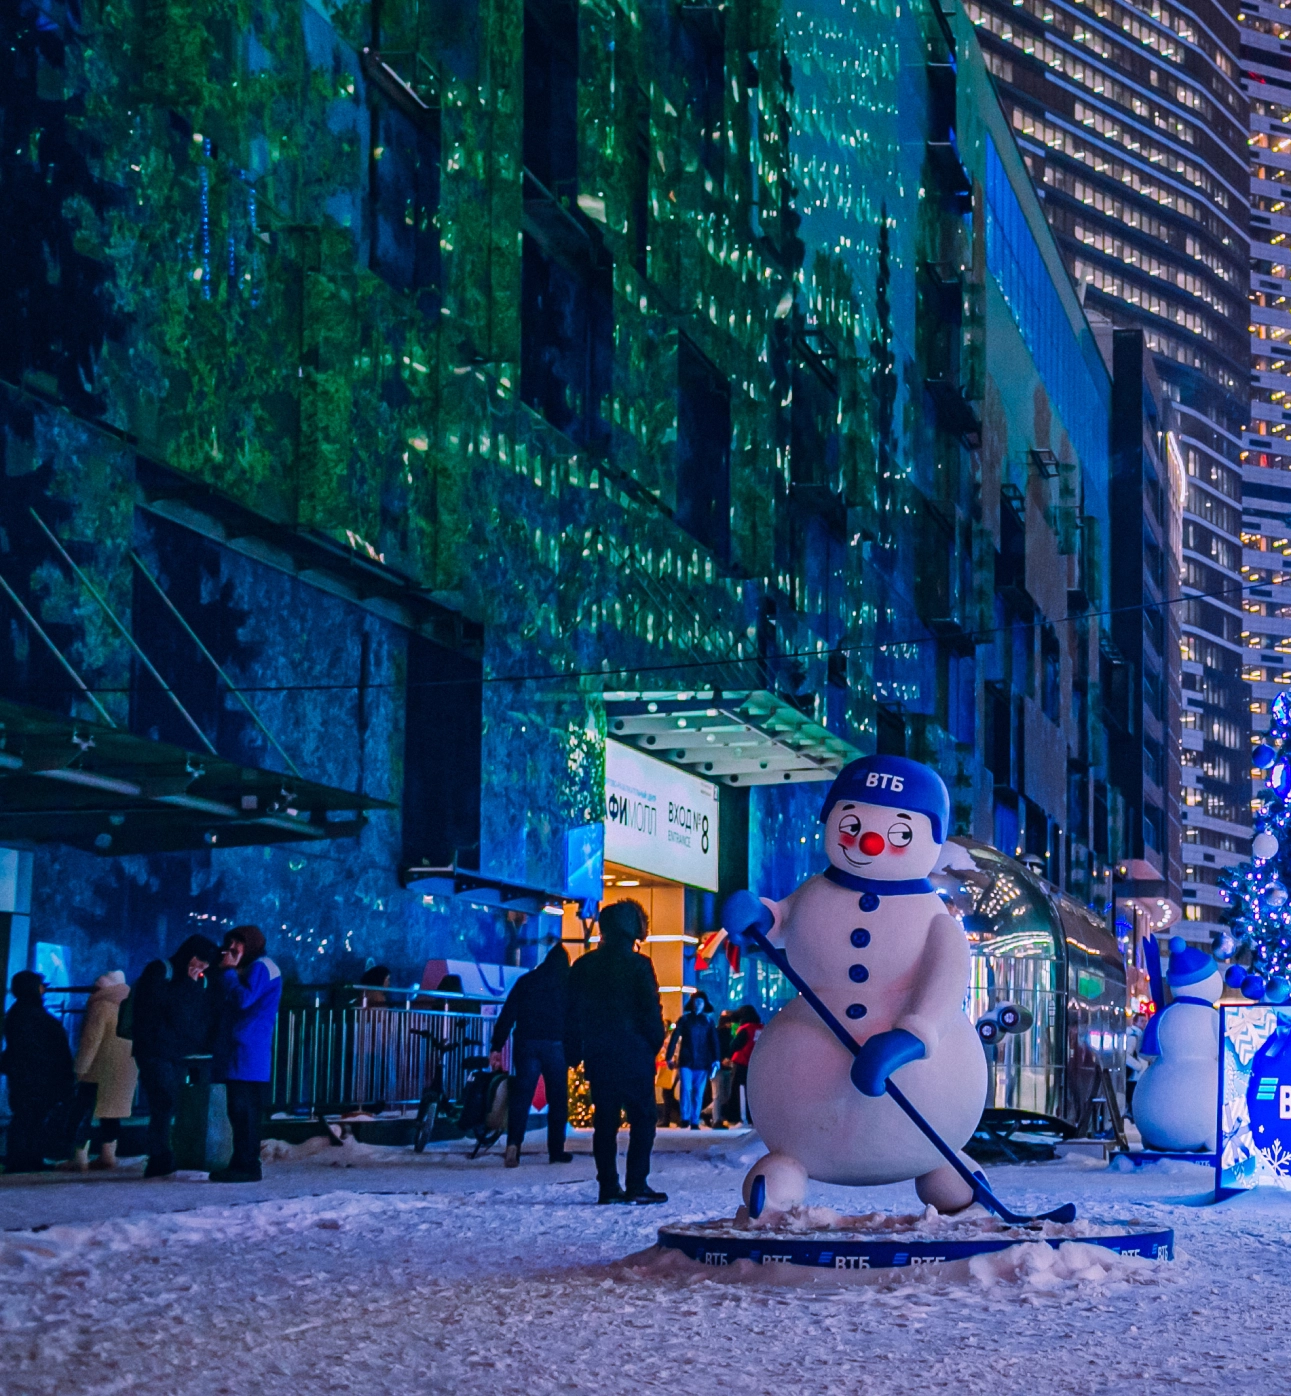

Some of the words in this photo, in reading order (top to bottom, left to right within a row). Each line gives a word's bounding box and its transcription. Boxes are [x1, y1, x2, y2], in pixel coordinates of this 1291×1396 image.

[866, 772, 905, 792] ВТБ
[669, 802, 691, 833] ВХОД
[835, 1256, 870, 1269] ВТБ
